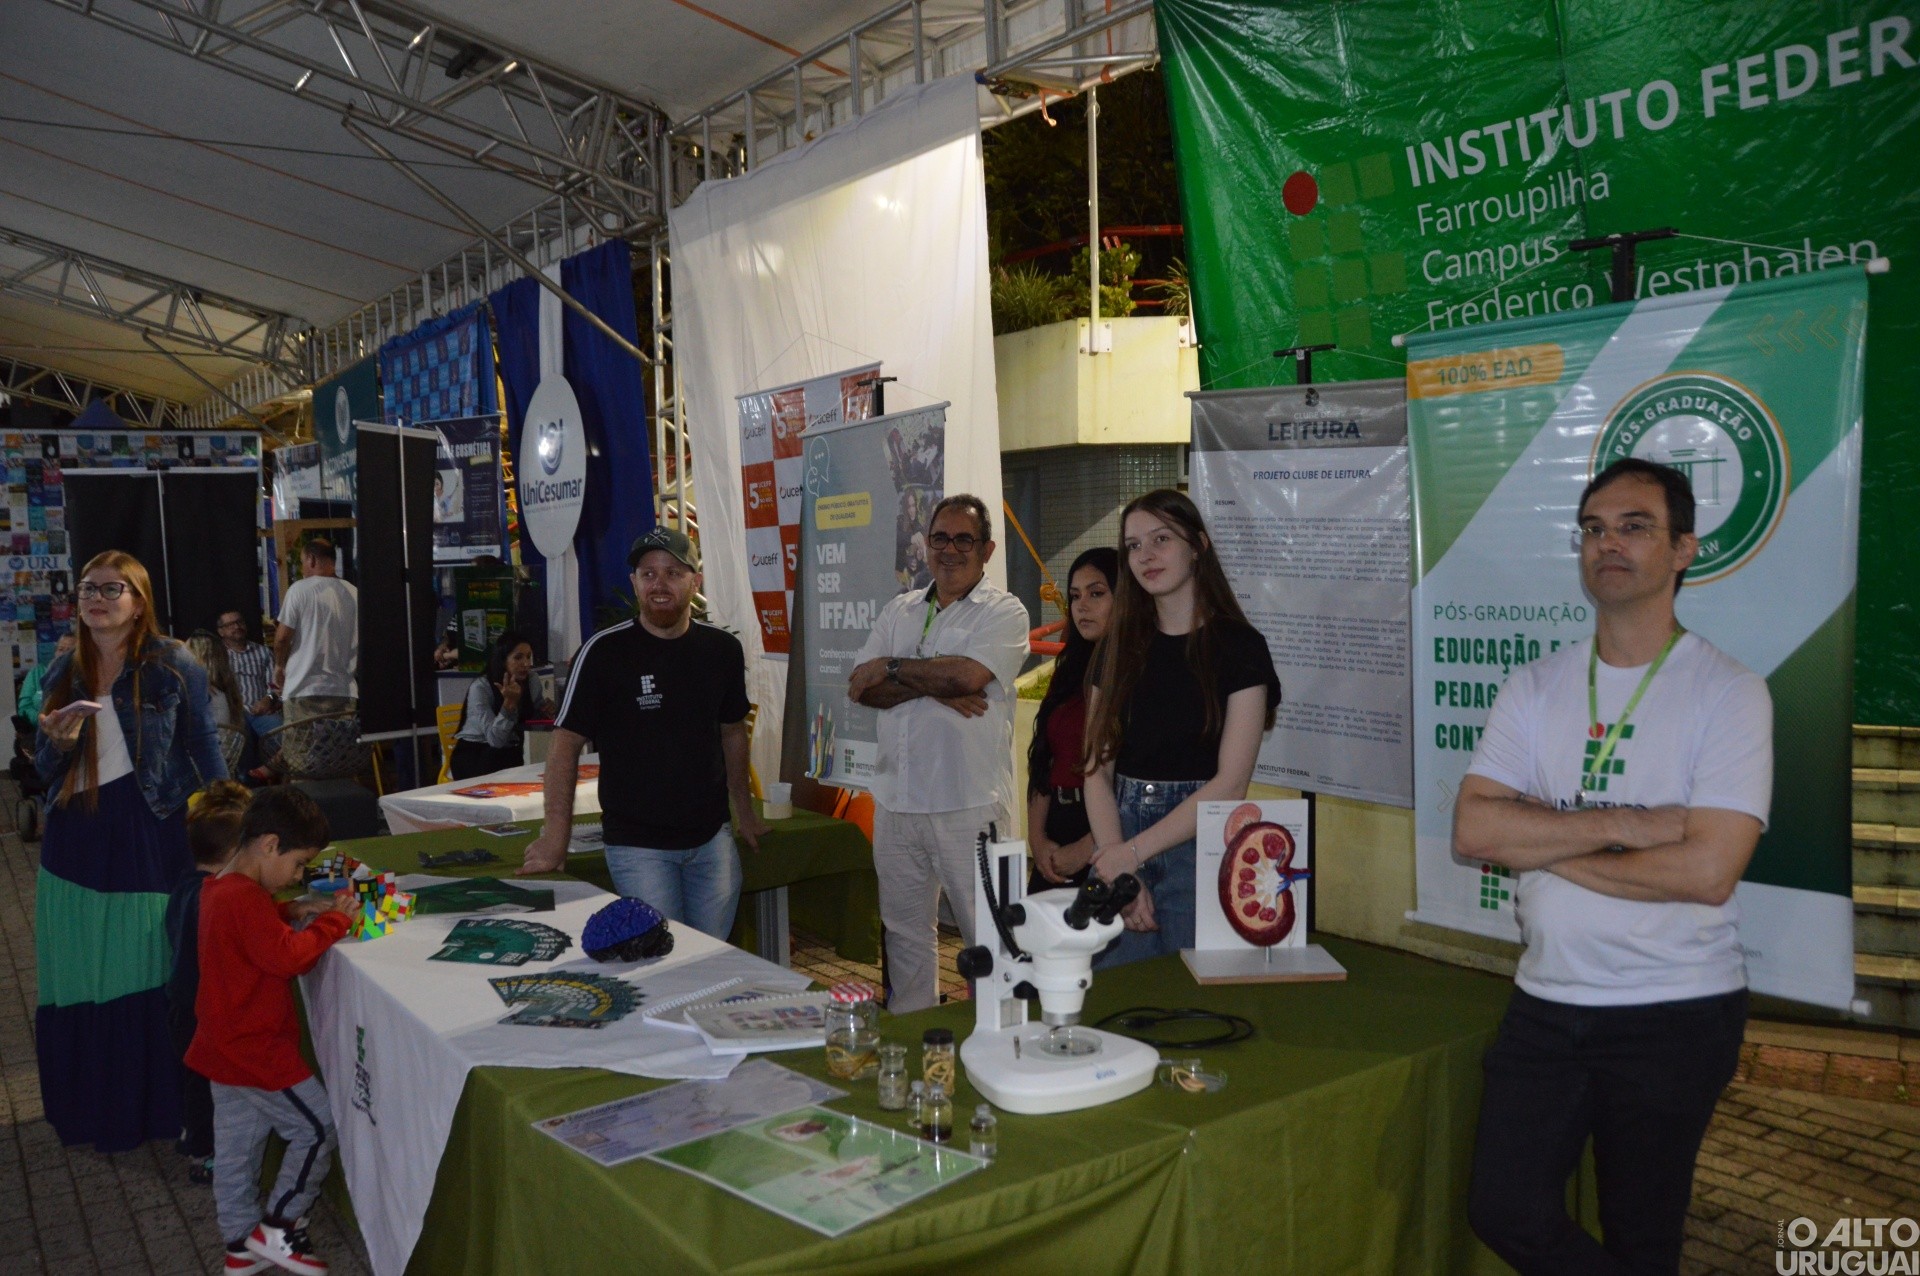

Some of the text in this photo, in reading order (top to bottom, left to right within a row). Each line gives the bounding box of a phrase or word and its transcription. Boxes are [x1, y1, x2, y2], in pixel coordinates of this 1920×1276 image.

[1405, 15, 1920, 188] INSTITUTO FEDER
[1417, 170, 1610, 236] Farroupilha
[1422, 233, 1559, 285] Campus
[1427, 281, 1594, 331] Frederico
[1437, 357, 1534, 385] 100% EAD
[1268, 420, 1361, 442] LEITURA
[1614, 395, 1753, 457] PÓS-GRADUAÇÃO
[1253, 469, 1371, 480] PROJETO CLUBE DE LEITURA
[523, 478, 583, 507] UniCesumar
[750, 482, 760, 509] 5
[28, 556, 58, 569] URI
[785, 544, 797, 571] 5
[816, 543, 846, 565] VEM
[817, 572, 841, 594] SER
[819, 600, 876, 630] IFFAR!
[1434, 601, 1587, 626] PÓS-GRADUAÇÃO
[1434, 633, 1540, 674] EDUCAÇÃO
[1435, 680, 1498, 709] PEDAG
[1435, 723, 1484, 751] CONT
[1257, 764, 1310, 777] INSTITUTO FEDERAL
